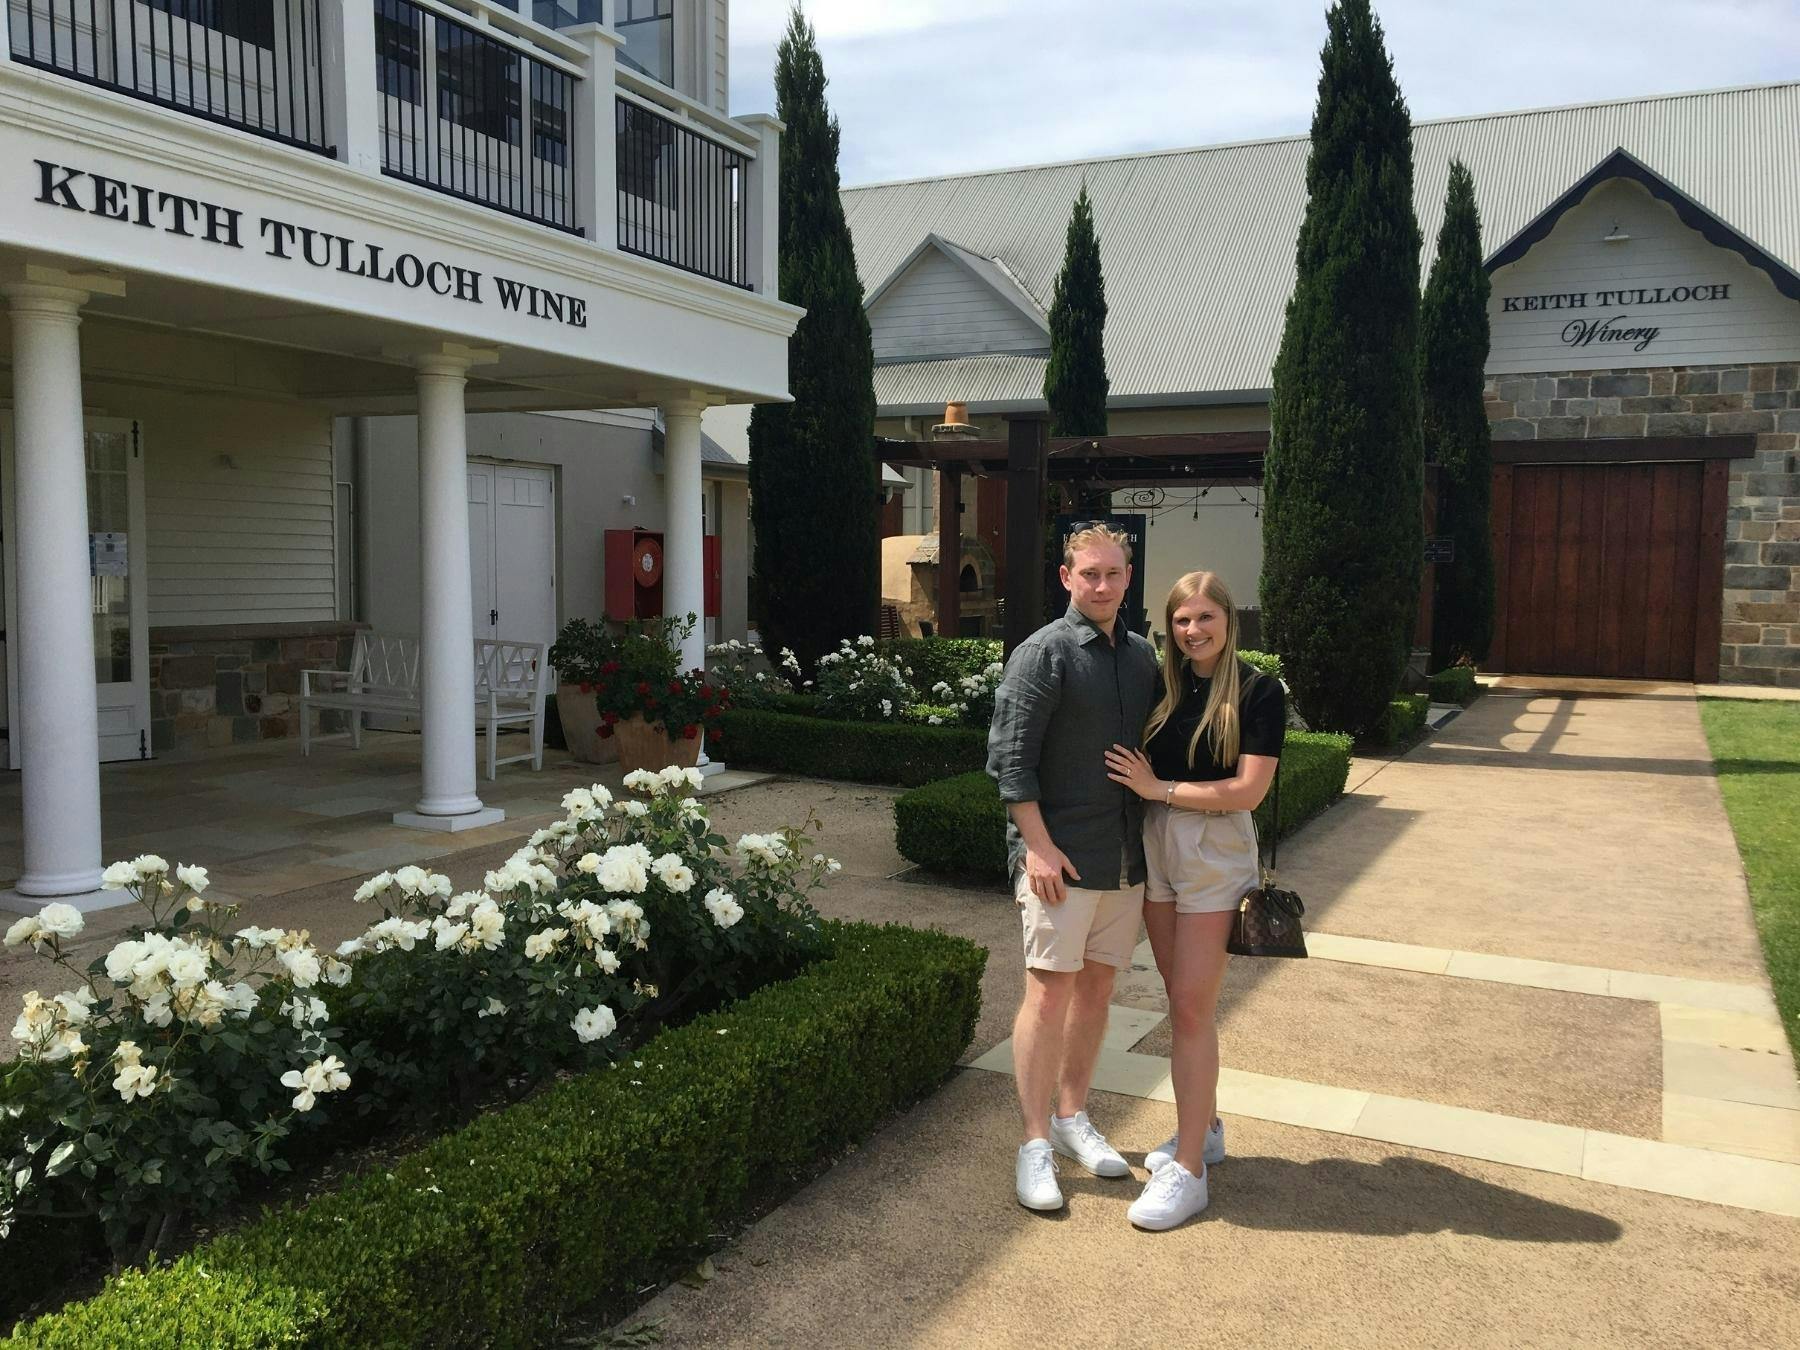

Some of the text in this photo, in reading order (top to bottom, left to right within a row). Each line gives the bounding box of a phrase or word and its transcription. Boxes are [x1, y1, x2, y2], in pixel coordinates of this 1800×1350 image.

[33, 158, 588, 329] KEITH TULLOCH WINE
[1502, 284, 1731, 312] KEITH TULLOCH
[1561, 315, 1660, 352] Winery
